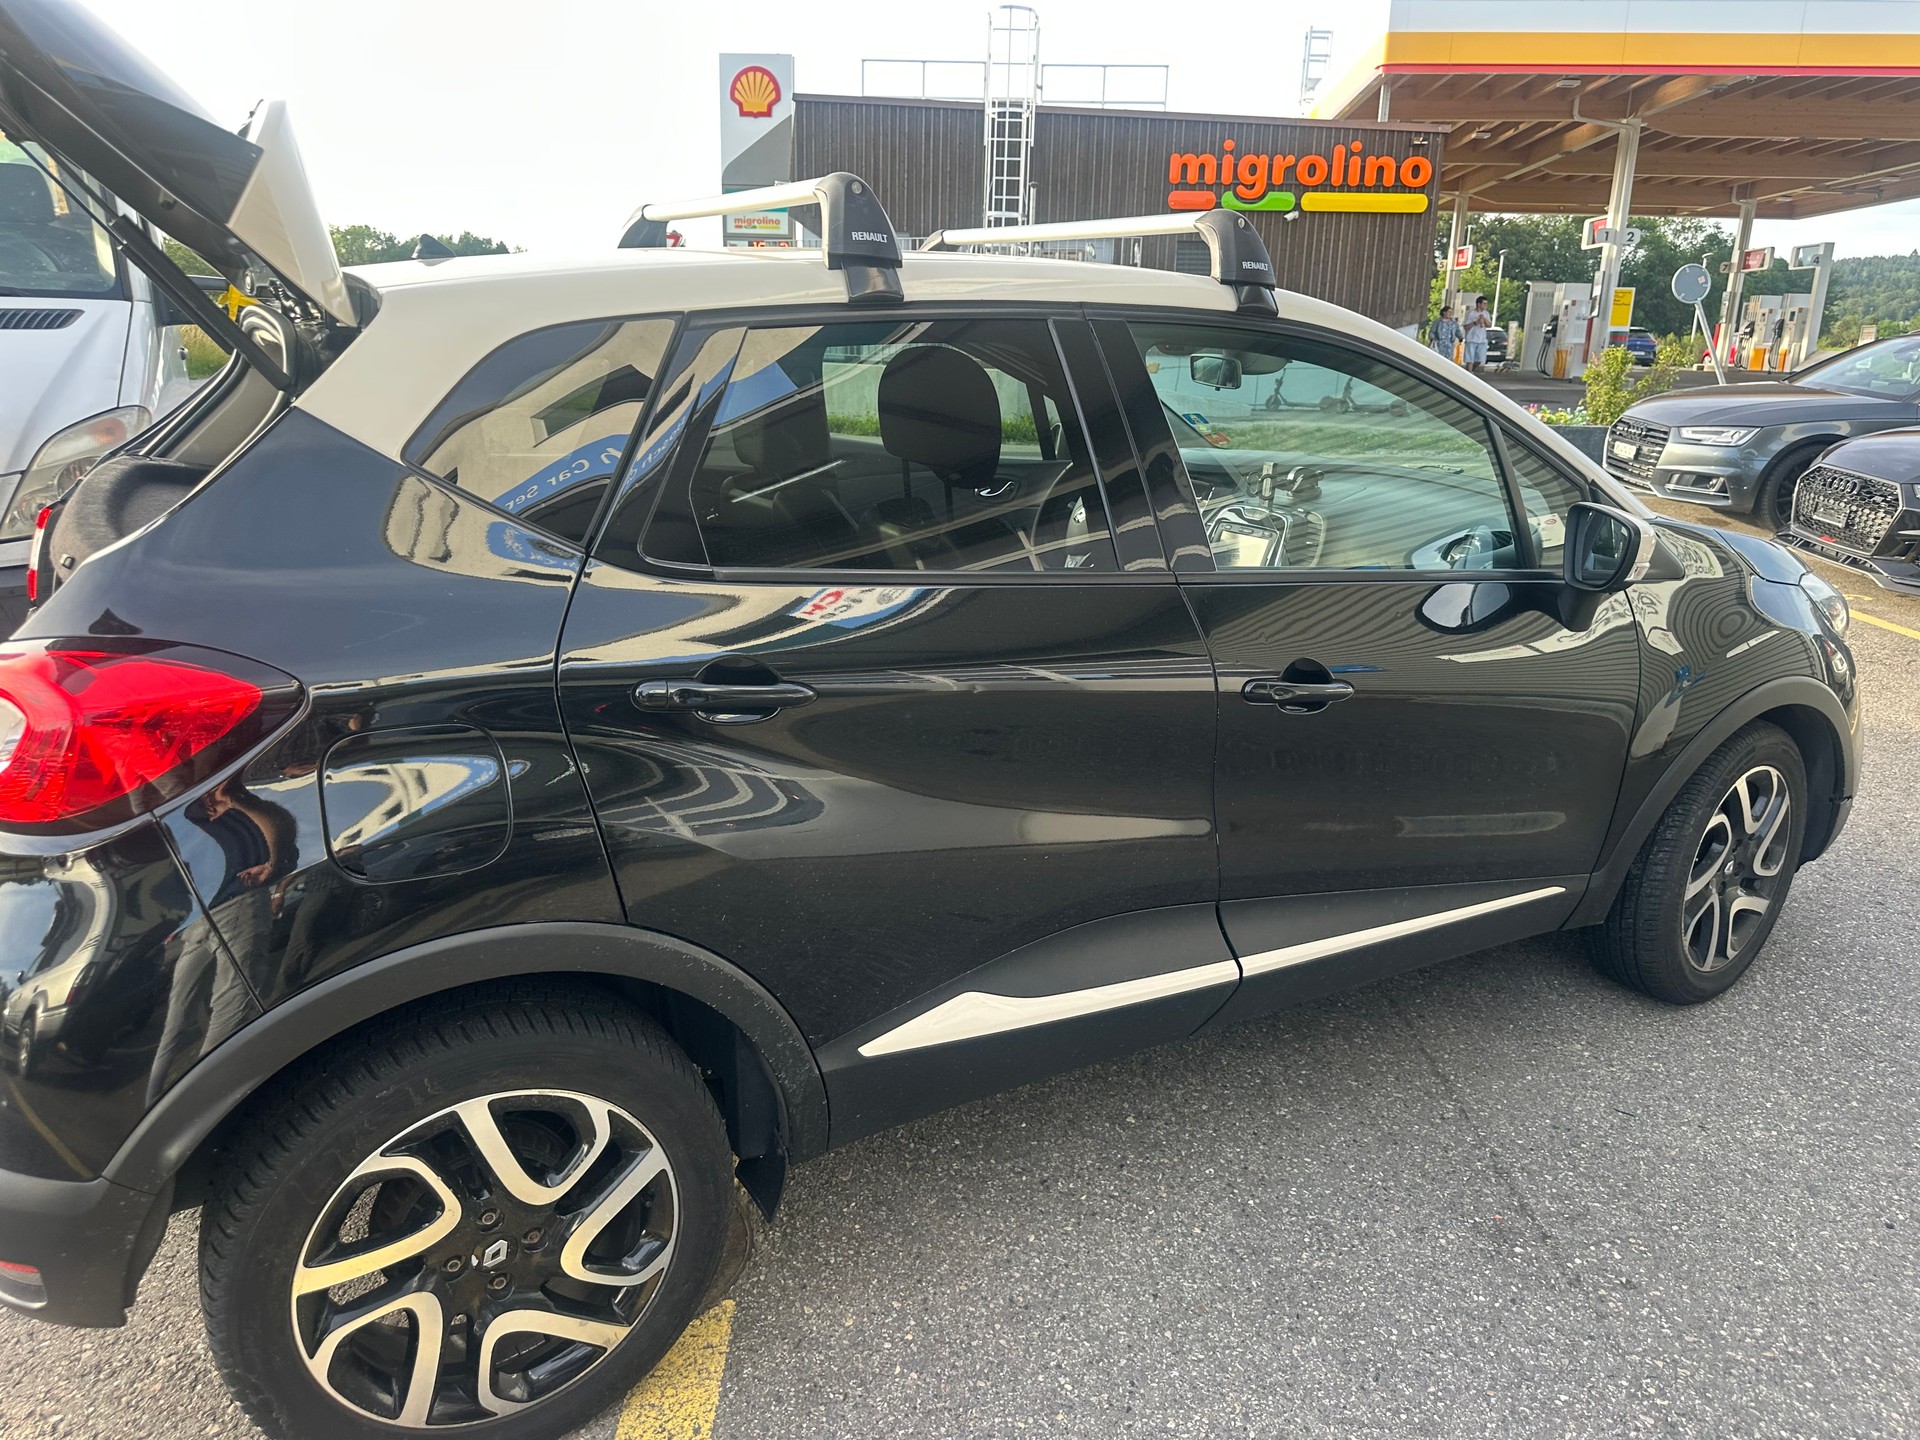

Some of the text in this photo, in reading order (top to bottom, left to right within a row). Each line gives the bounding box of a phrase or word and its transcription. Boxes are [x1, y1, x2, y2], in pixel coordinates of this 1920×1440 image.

[1168, 139, 1432, 199] migrolino
[733, 217, 781, 227] migrolino
[851, 231, 888, 244] RENAULT
[1604, 231, 1610, 241] 1
[1626, 231, 1635, 242] 2
[1812, 256, 1820, 265] 4
[1242, 260, 1269, 272] RENAULT
[1721, 263, 1729, 272] 7
